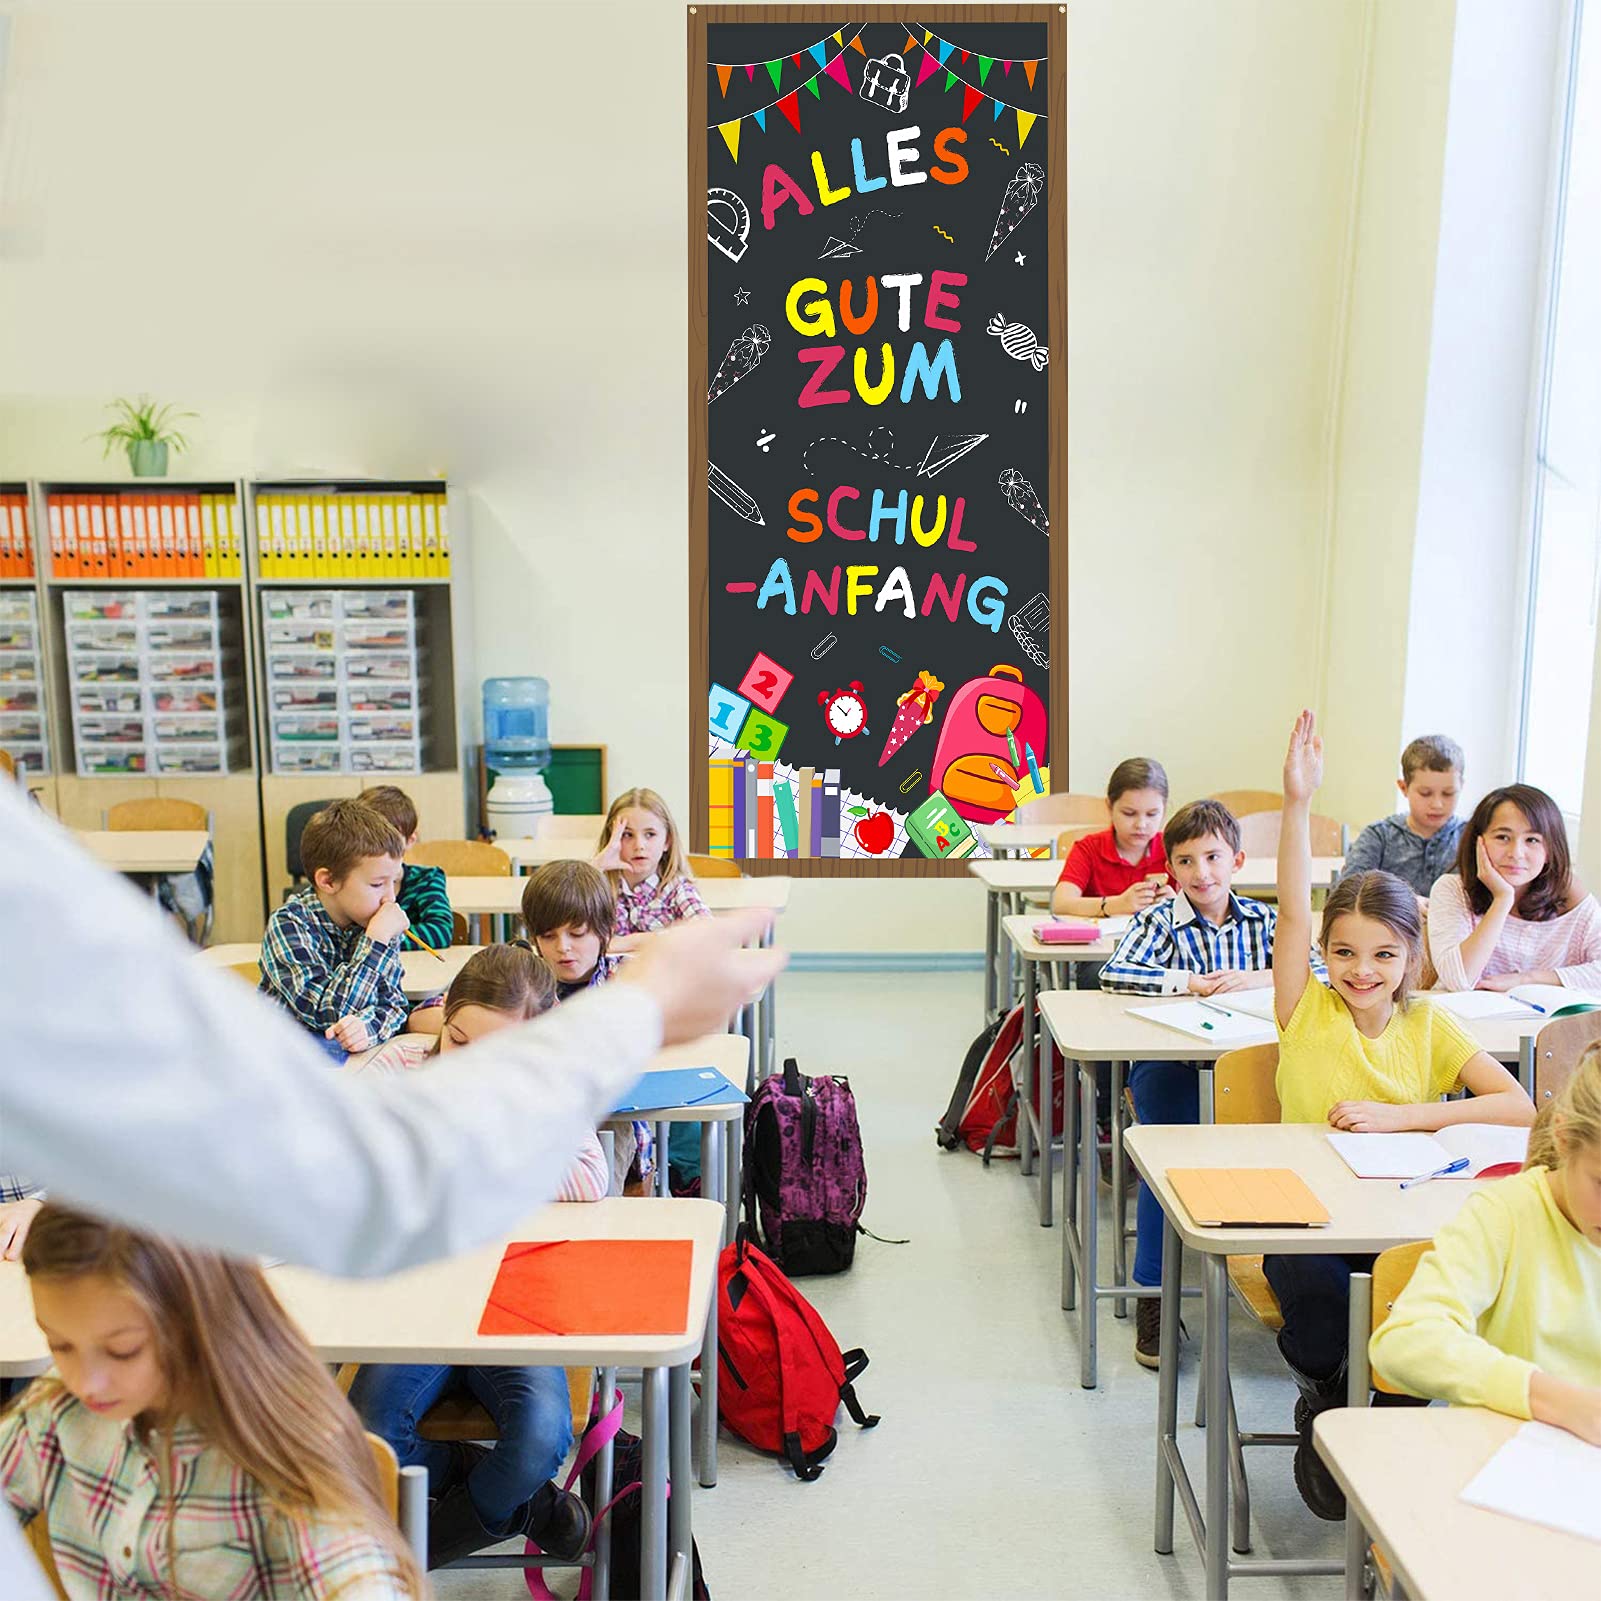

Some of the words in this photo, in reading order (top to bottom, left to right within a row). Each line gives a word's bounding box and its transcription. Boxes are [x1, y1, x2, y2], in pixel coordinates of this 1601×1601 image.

[760, 125, 970, 230] ALLES
[785, 270, 969, 338] GUTE
[797, 338, 962, 409] ZUM
[786, 485, 978, 553] SCHUL
[725, 557, 1009, 634] -ANFANG
[751, 670, 778, 700] 2
[748, 723, 773, 752] 3
